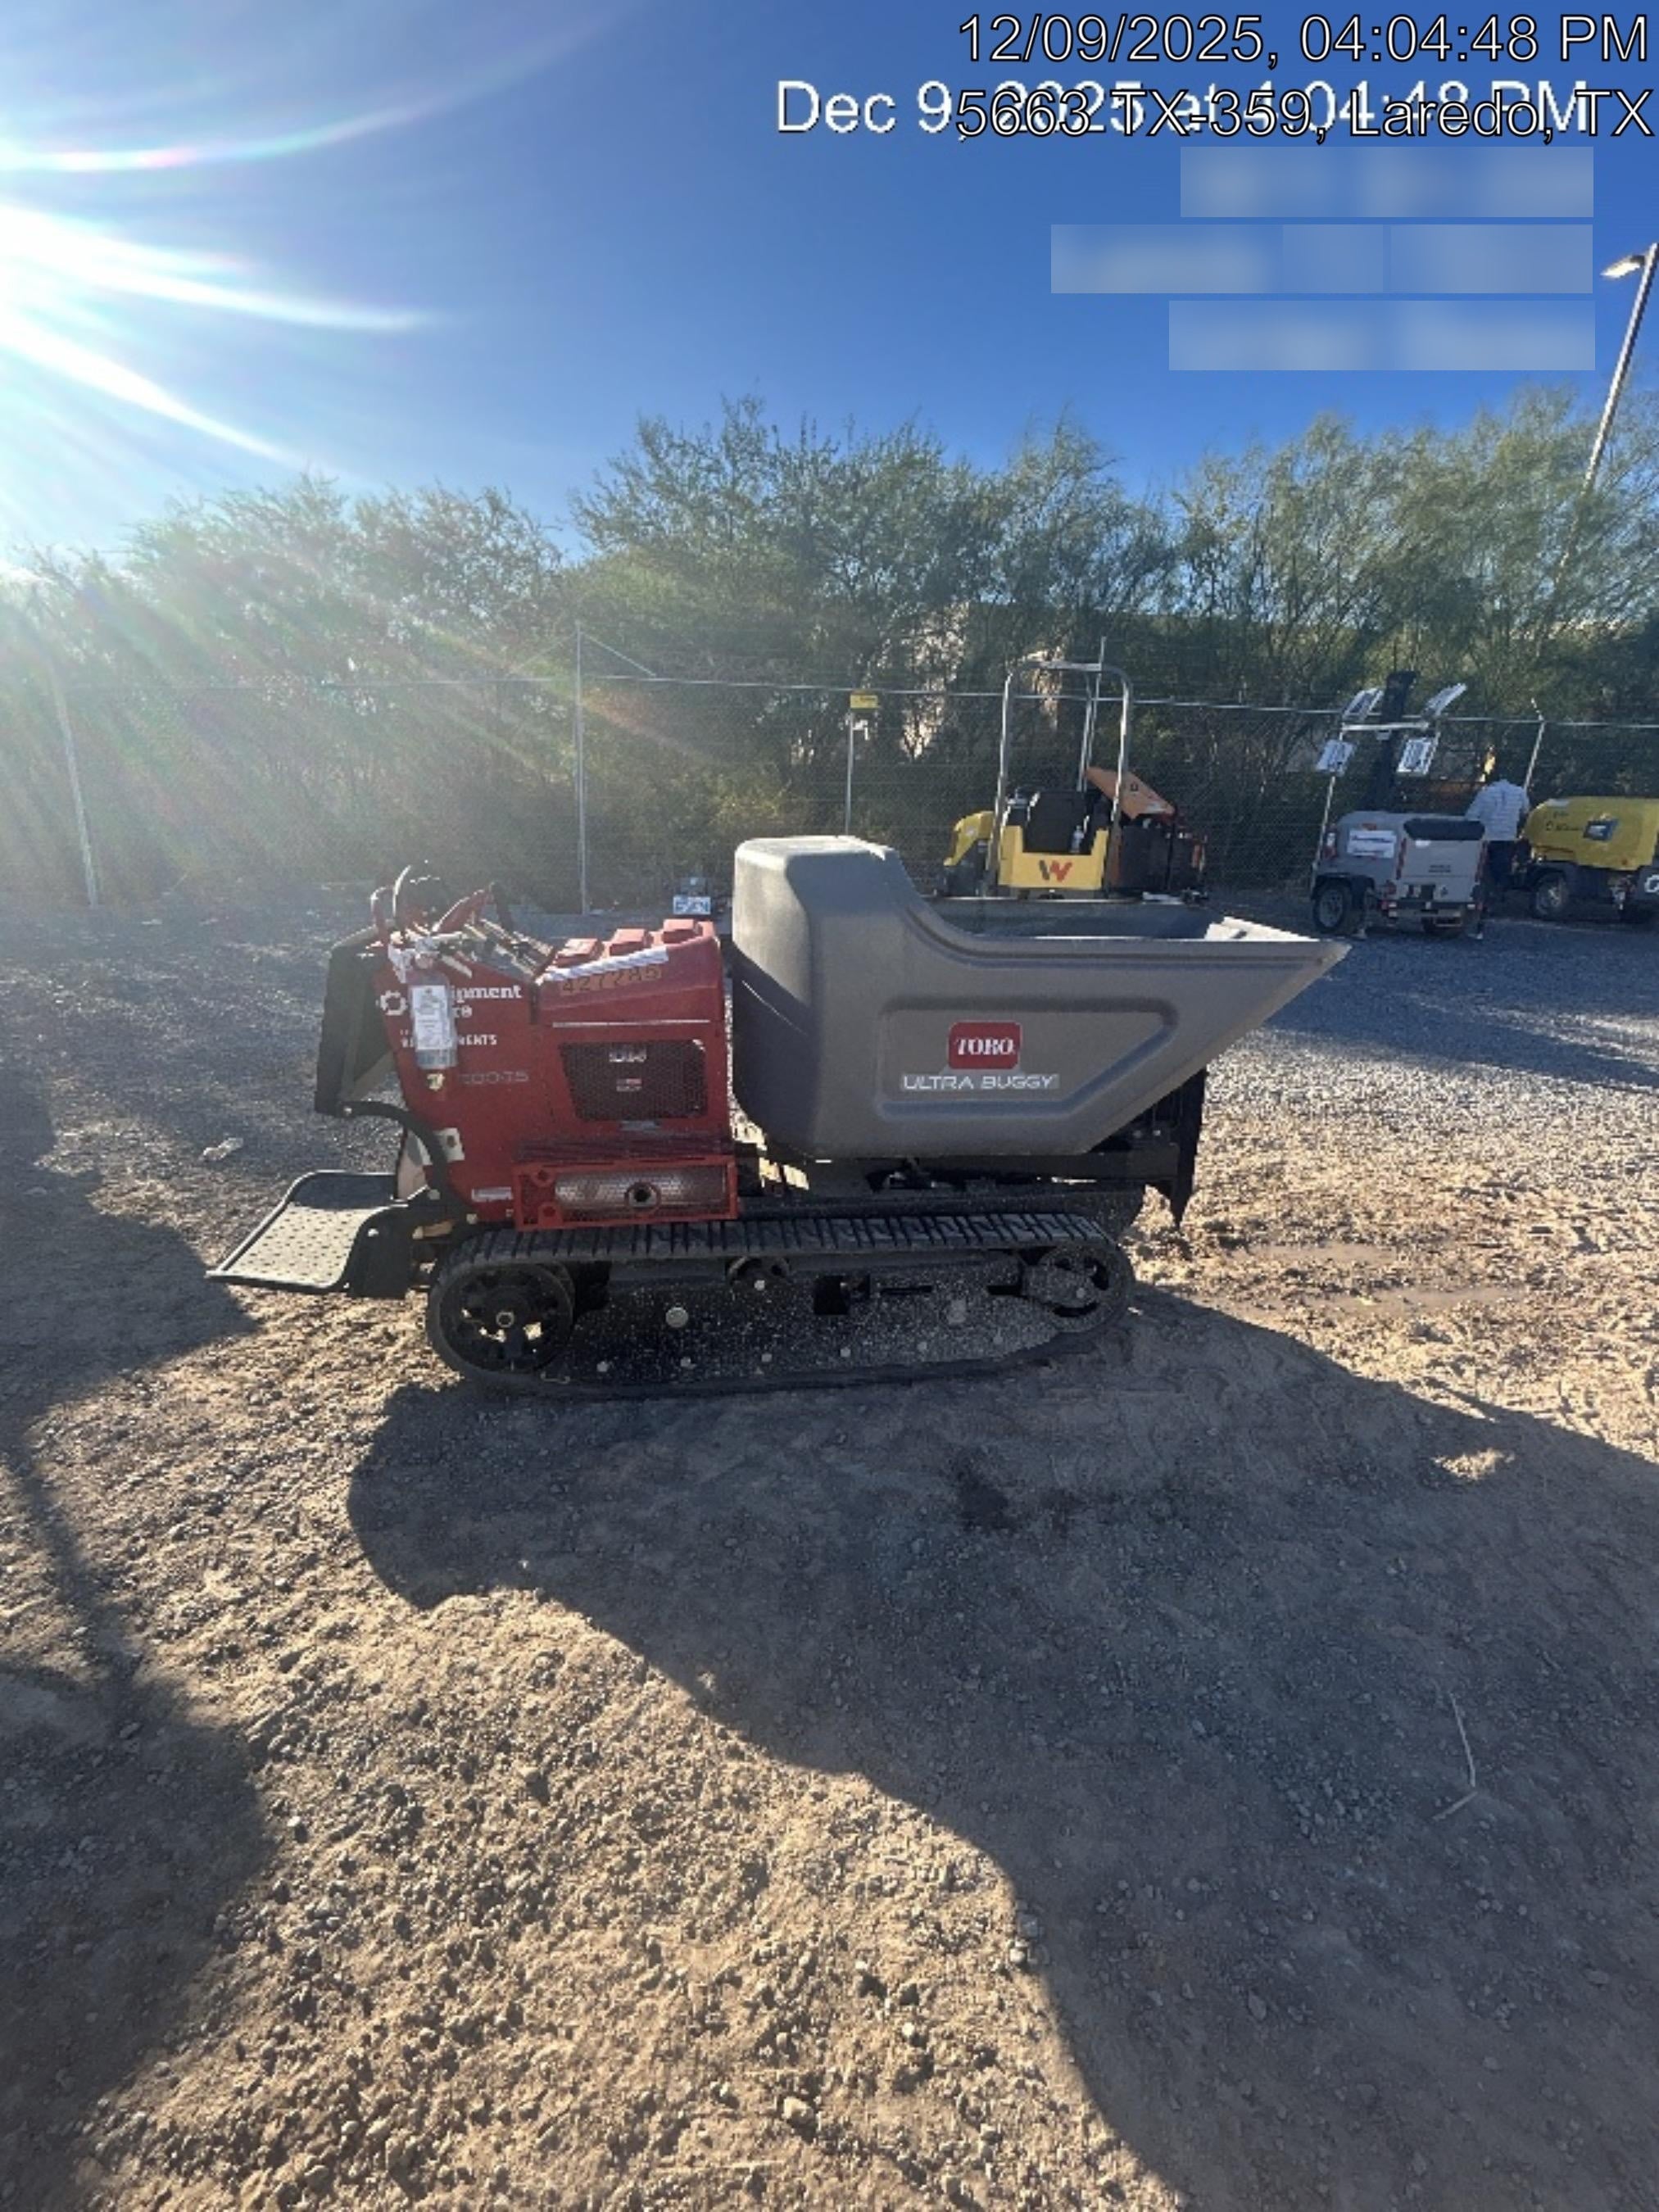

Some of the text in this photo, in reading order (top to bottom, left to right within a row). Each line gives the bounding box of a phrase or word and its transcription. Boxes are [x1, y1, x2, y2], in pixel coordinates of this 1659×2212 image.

[955, 1038, 1015, 1056] TORO
[903, 1074, 1054, 1090] ULTRA BUGGY
